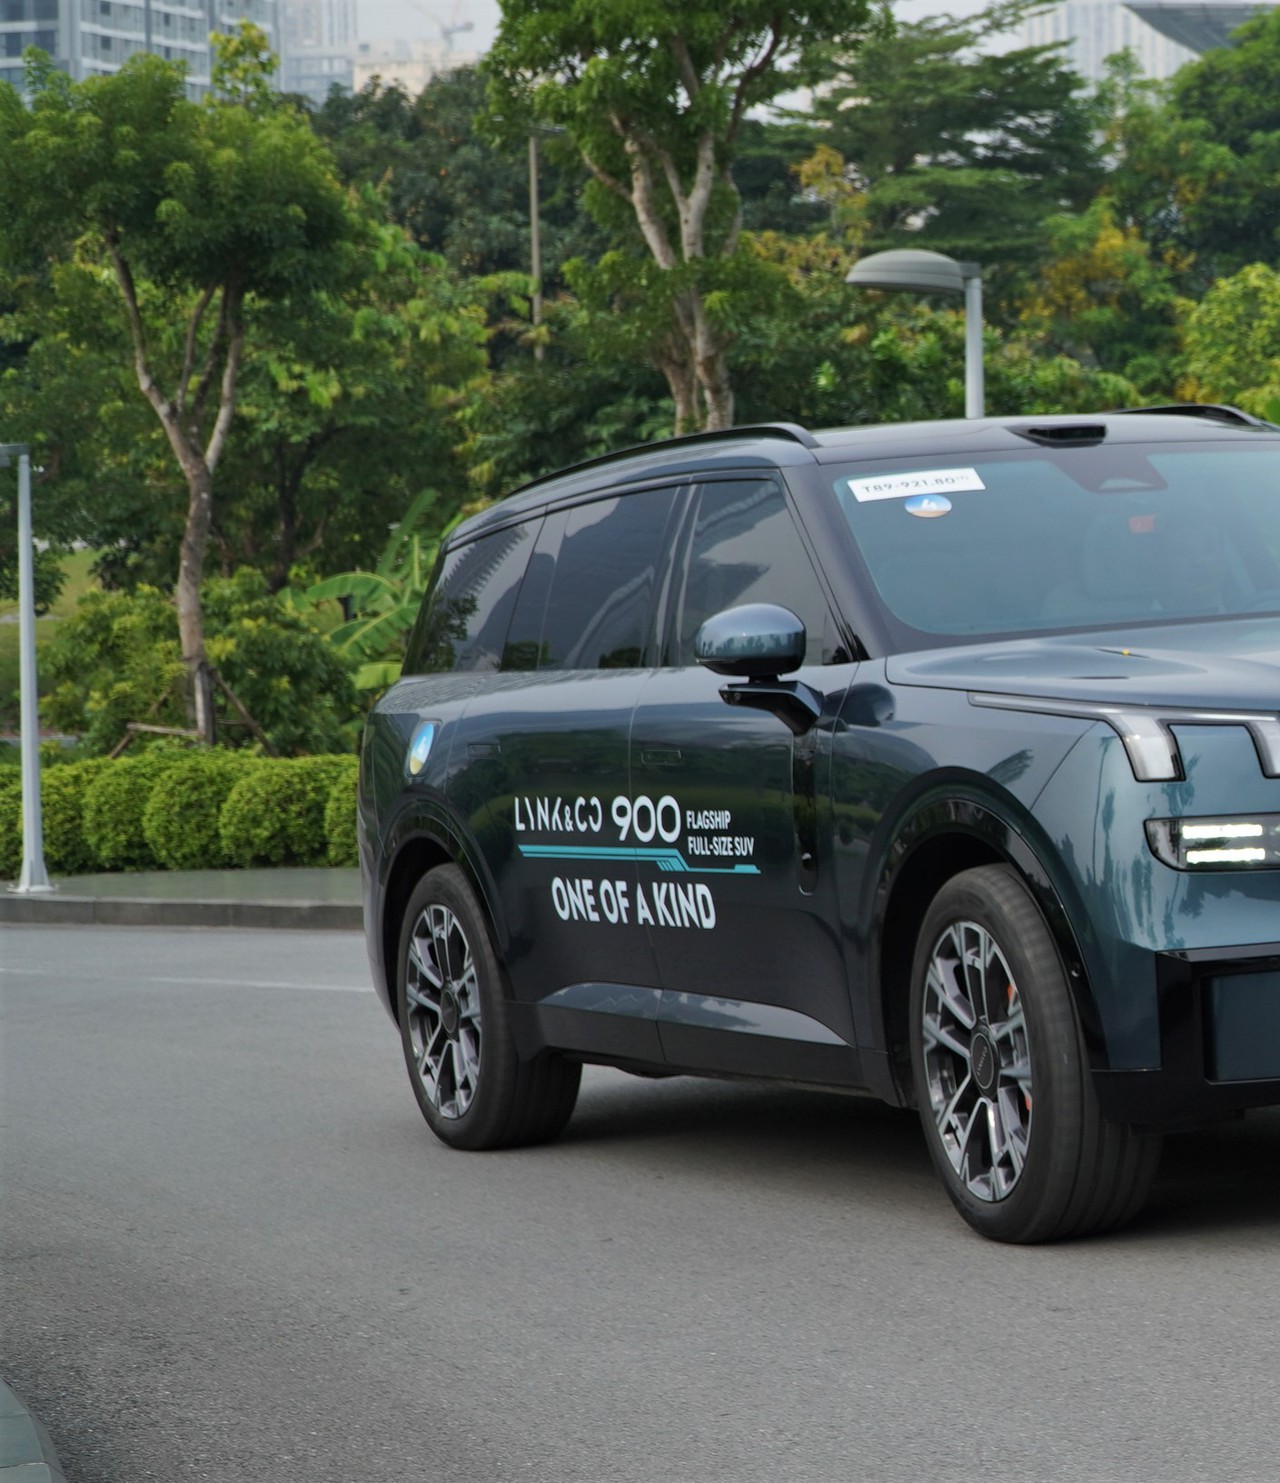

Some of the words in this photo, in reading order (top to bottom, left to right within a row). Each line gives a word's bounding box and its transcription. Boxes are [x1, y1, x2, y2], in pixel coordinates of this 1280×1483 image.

[611, 795, 682, 843] 900
[686, 810, 731, 830] FLAGSHIP
[688, 836, 734, 857] FULL-SIZE
[734, 837, 755, 857] SUV
[551, 876, 601, 922] ONE
[600, 878, 629, 925] OF
[637, 882, 655, 926] A
[652, 882, 716, 929] KIND
